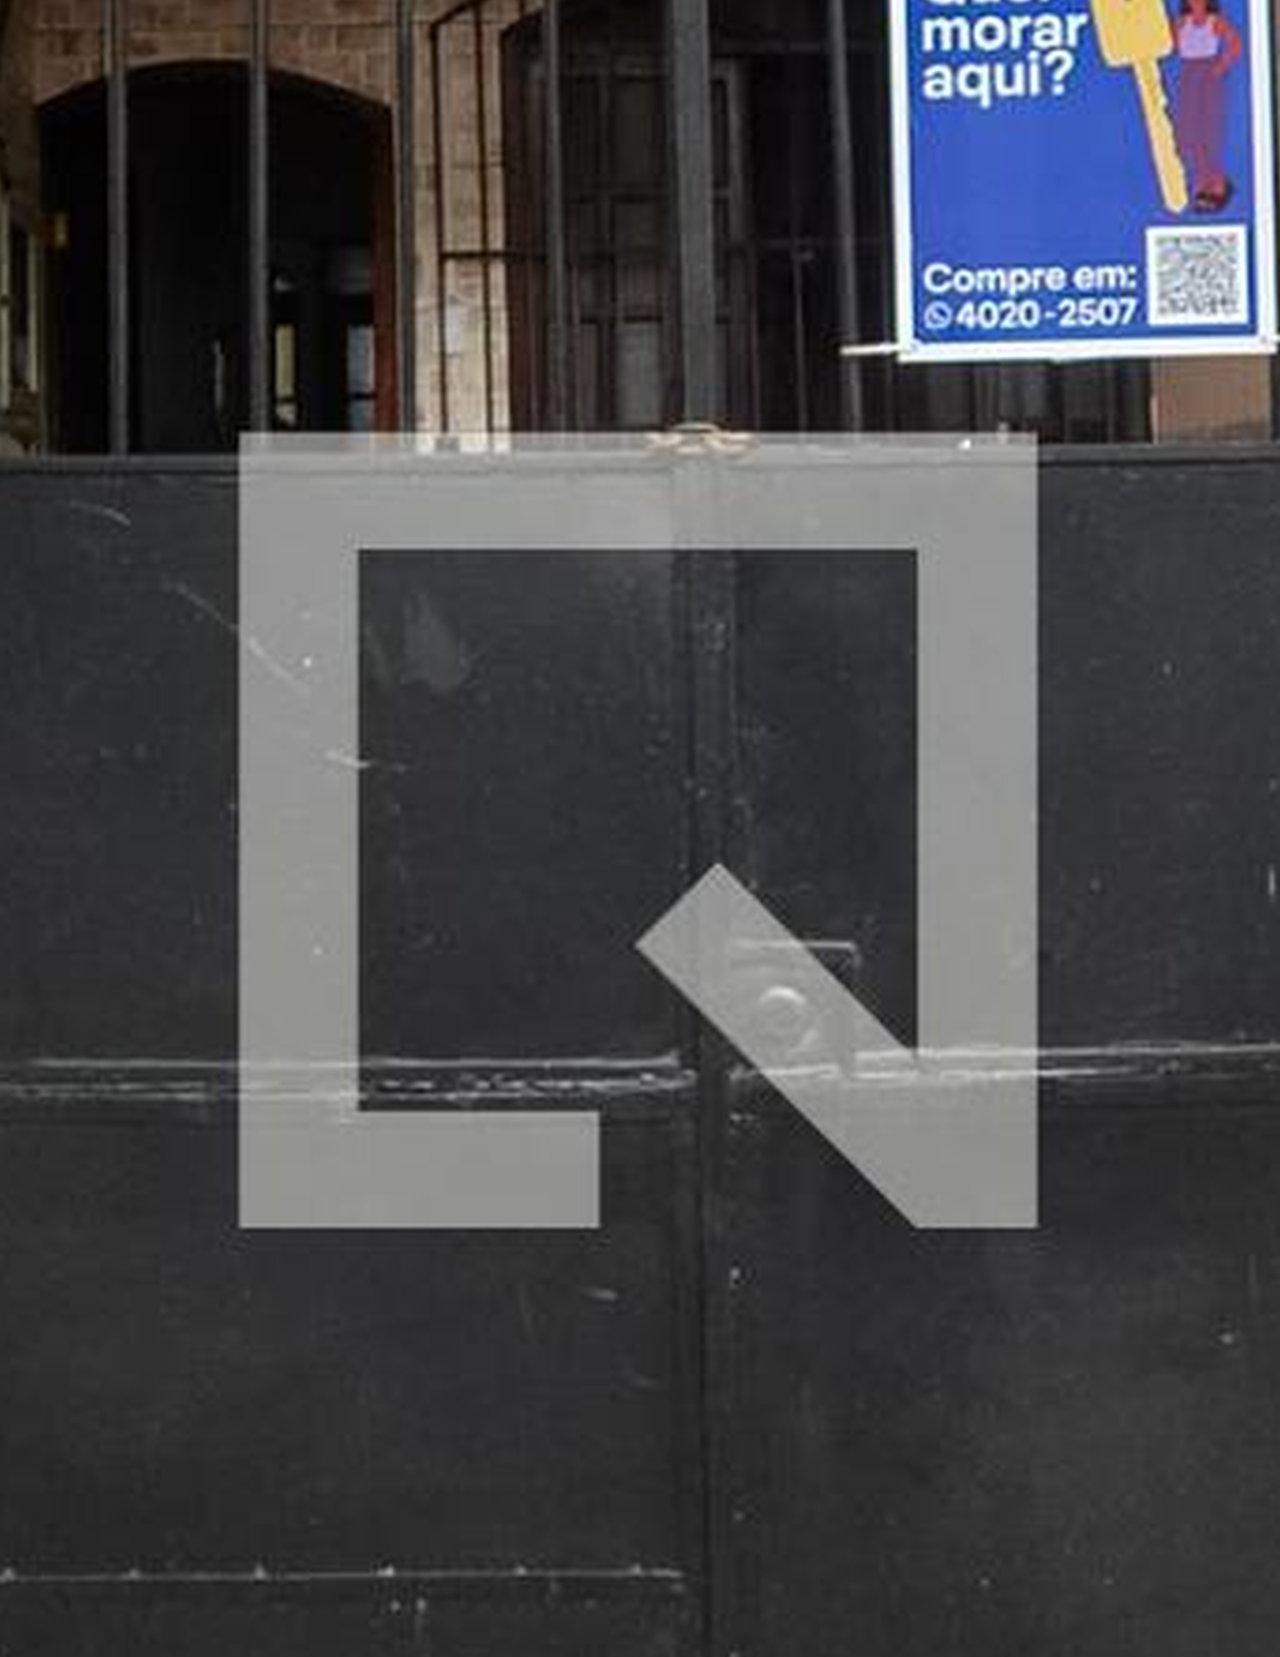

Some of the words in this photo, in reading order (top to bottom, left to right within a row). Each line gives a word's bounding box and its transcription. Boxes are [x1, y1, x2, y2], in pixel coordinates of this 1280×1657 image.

[922, 12, 1087, 51] morar
[923, 50, 1074, 108] aqui?
[923, 263, 1071, 296] Compre
[1073, 265, 1137, 290] em:
